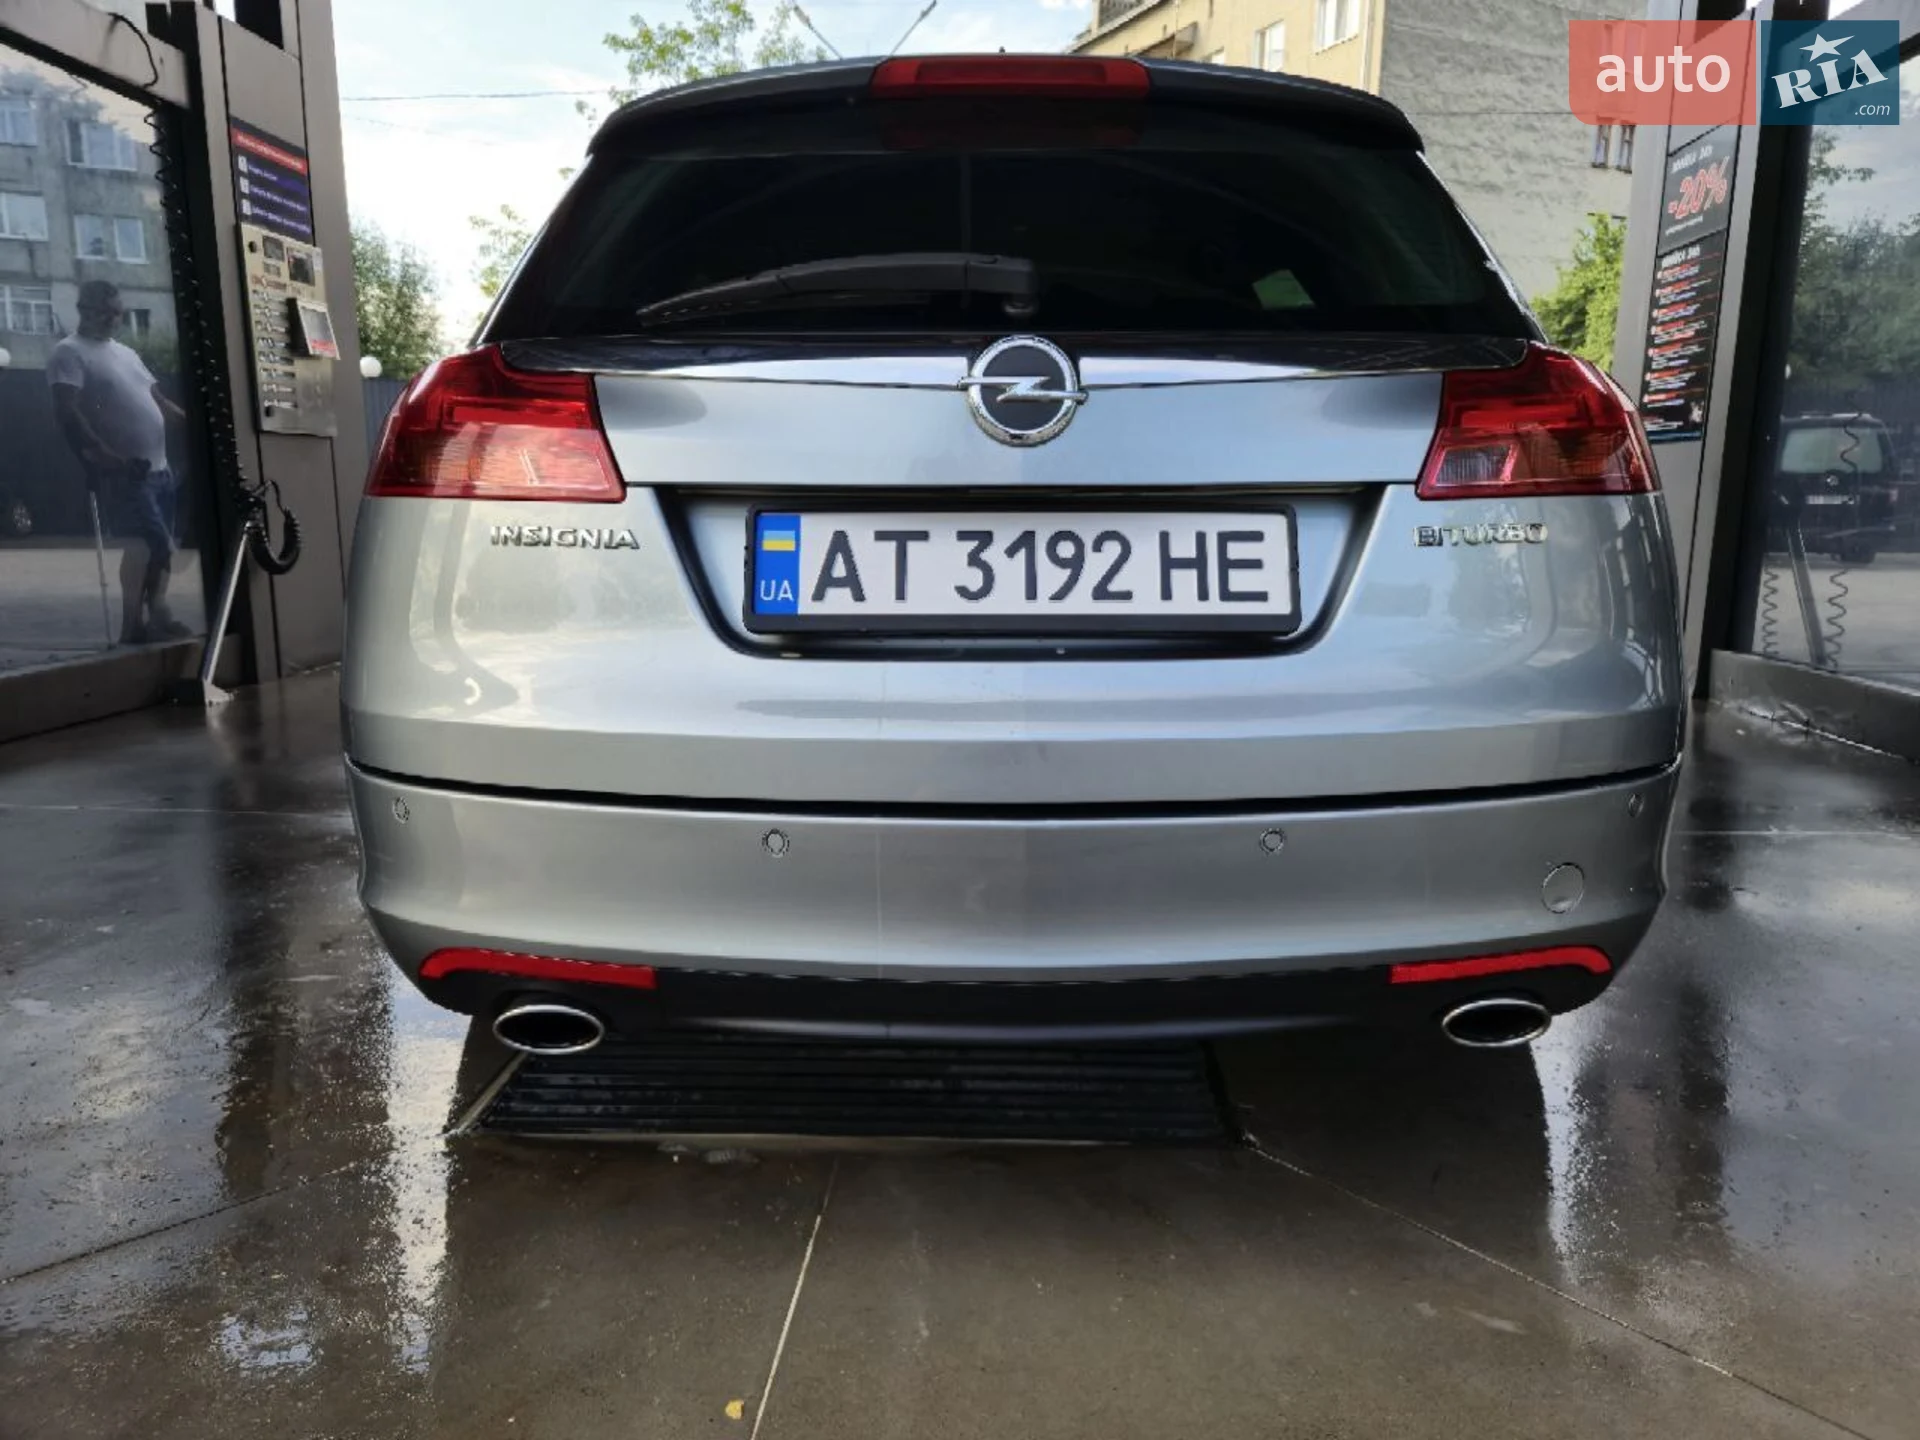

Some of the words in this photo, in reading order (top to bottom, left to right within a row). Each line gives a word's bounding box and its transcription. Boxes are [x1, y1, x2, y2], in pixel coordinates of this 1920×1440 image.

[1667, 155, 1730, 220] -20%
[490, 525, 640, 550] INSIGNIA
[1413, 523, 1548, 547] BITURBO
[811, 530, 930, 602] AT
[954, 530, 1134, 602] 3192
[1159, 530, 1269, 602] HE
[760, 579, 794, 601] UA
